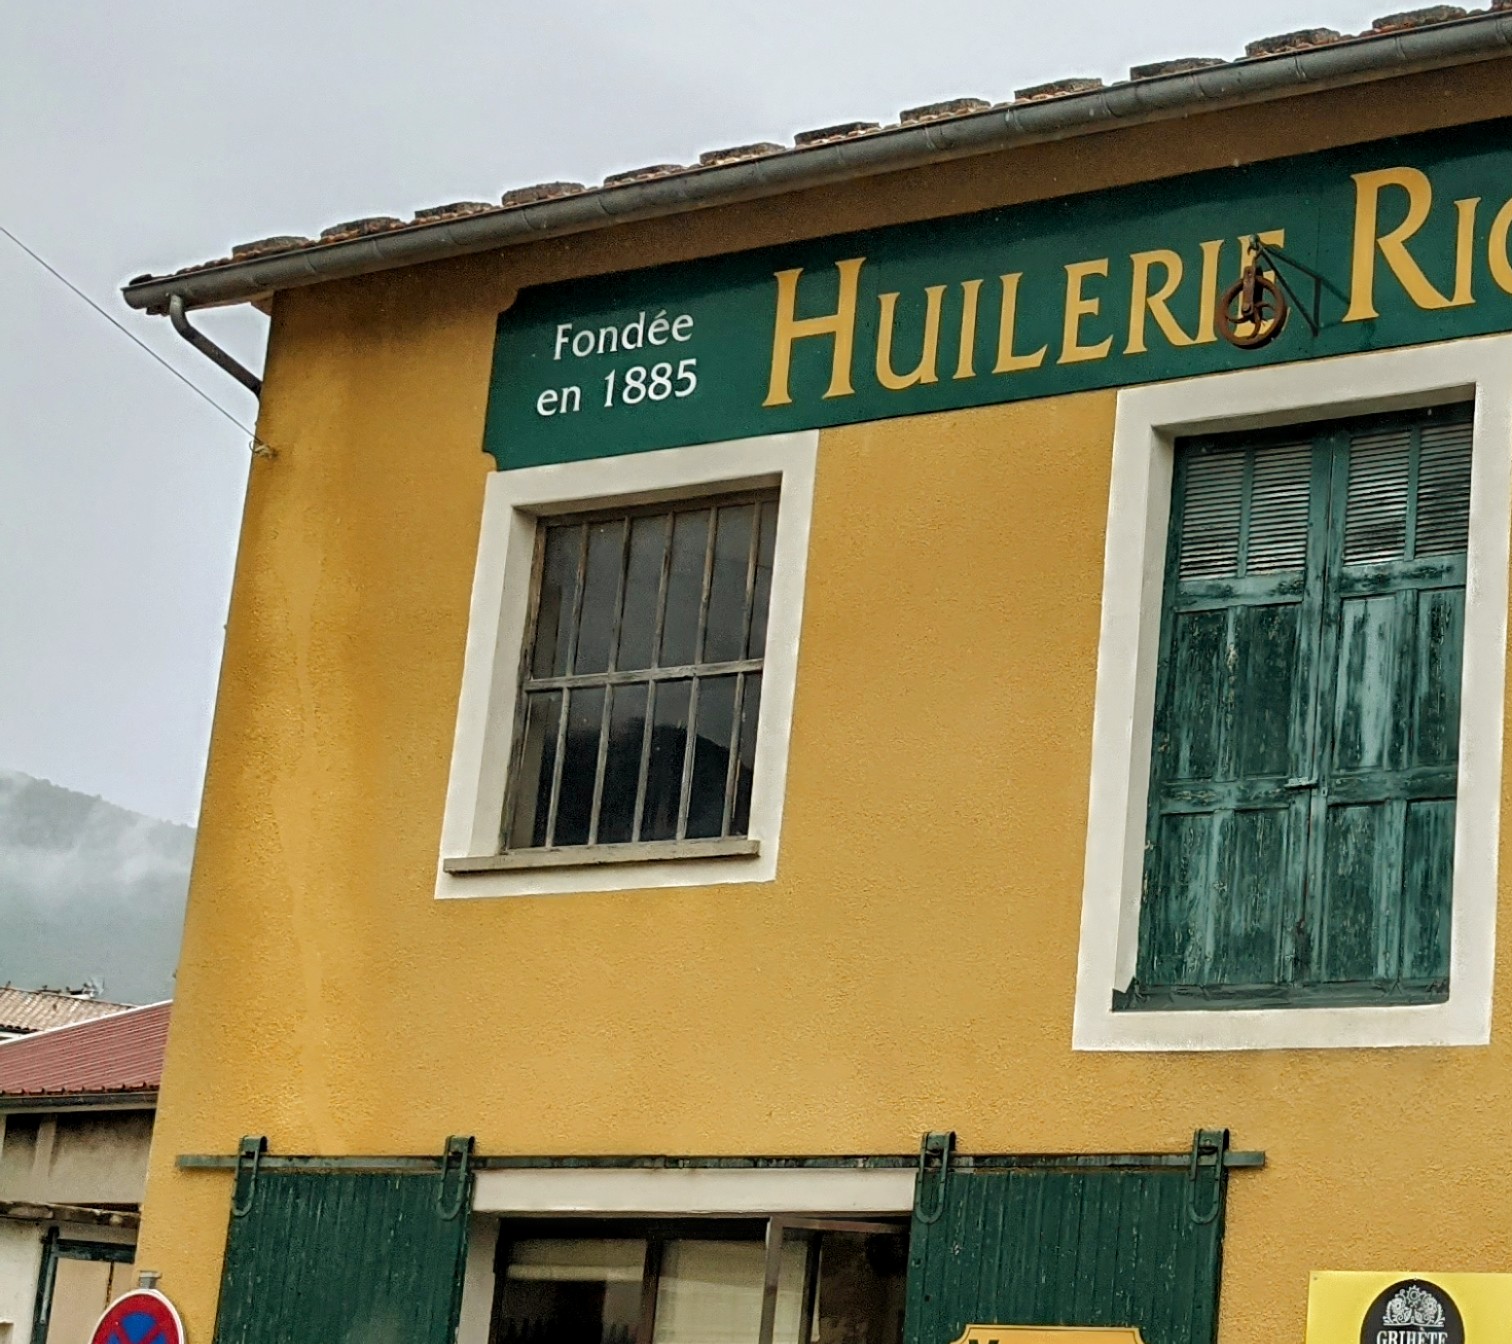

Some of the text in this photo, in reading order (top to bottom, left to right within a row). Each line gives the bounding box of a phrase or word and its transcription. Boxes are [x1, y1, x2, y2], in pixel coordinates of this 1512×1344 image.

[553, 309, 695, 361] Fondée
[536, 358, 698, 417] en 1885
